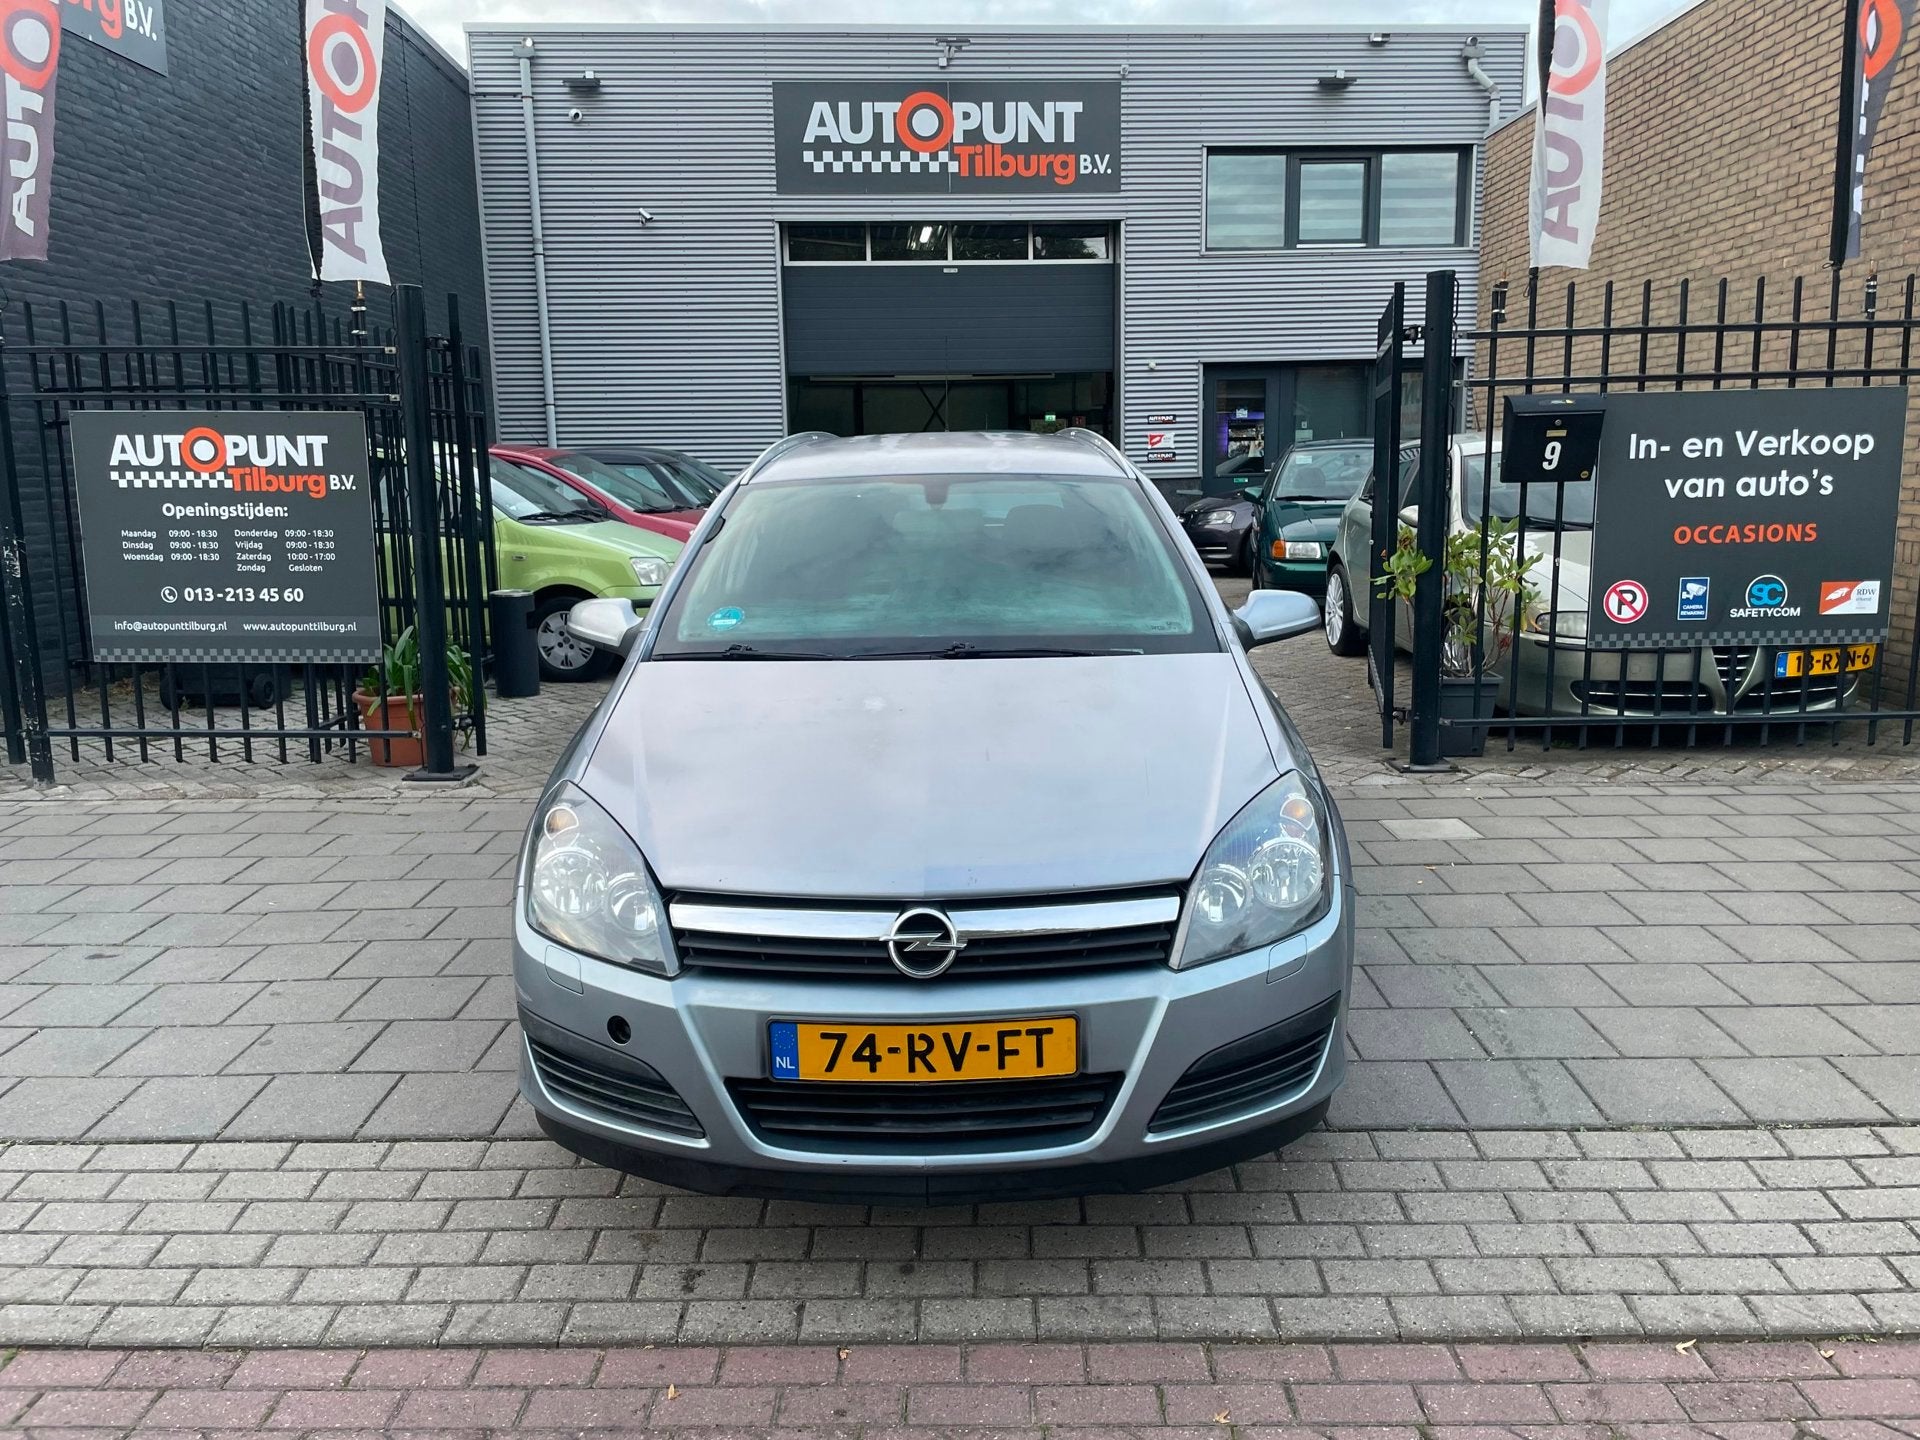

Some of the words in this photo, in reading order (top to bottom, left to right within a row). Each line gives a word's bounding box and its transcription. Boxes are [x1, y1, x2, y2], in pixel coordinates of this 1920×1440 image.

[124, 0, 158, 41] B.V.
[803, 91, 1083, 153] AUTOPUNT
[953, 145, 1076, 185] Tilburg
[1079, 154, 1112, 175] B.V.
[109, 426, 328, 473] AUTOPUNT
[1629, 433, 1671, 460] In-
[1682, 437, 1724, 459] en
[1735, 428, 1875, 461] Verkoop
[1542, 441, 1562, 470] 9
[226, 466, 326, 499] Tilburg
[329, 474, 357, 491] B.V.
[1664, 477, 1725, 499] van
[1735, 468, 1834, 497] auto's
[162, 502, 289, 520] Openingstijden:
[121, 529, 157, 539] Maandag
[234, 528, 278, 539] Donderdag
[1673, 523, 1817, 545] OCCASIONS
[122, 540, 154, 551] Dinsdag
[234, 540, 263, 551] Vrijdag
[122, 552, 164, 562] Woensdag
[236, 552, 272, 562] Zaterdag
[236, 563, 266, 573] Zondag
[288, 563, 323, 572] Gesloten
[258, 587, 280, 602] 45
[283, 587, 304, 603] 60
[1856, 588, 1876, 596] RDW
[1728, 606, 1802, 618] SAFETYCOM
[114, 620, 228, 633] info@autopunttilburg.nl
[242, 621, 357, 633] www.autopunttilburg.nl
[819, 1026, 1055, 1073] 74-RV-FT
[775, 1055, 796, 1070] NL
